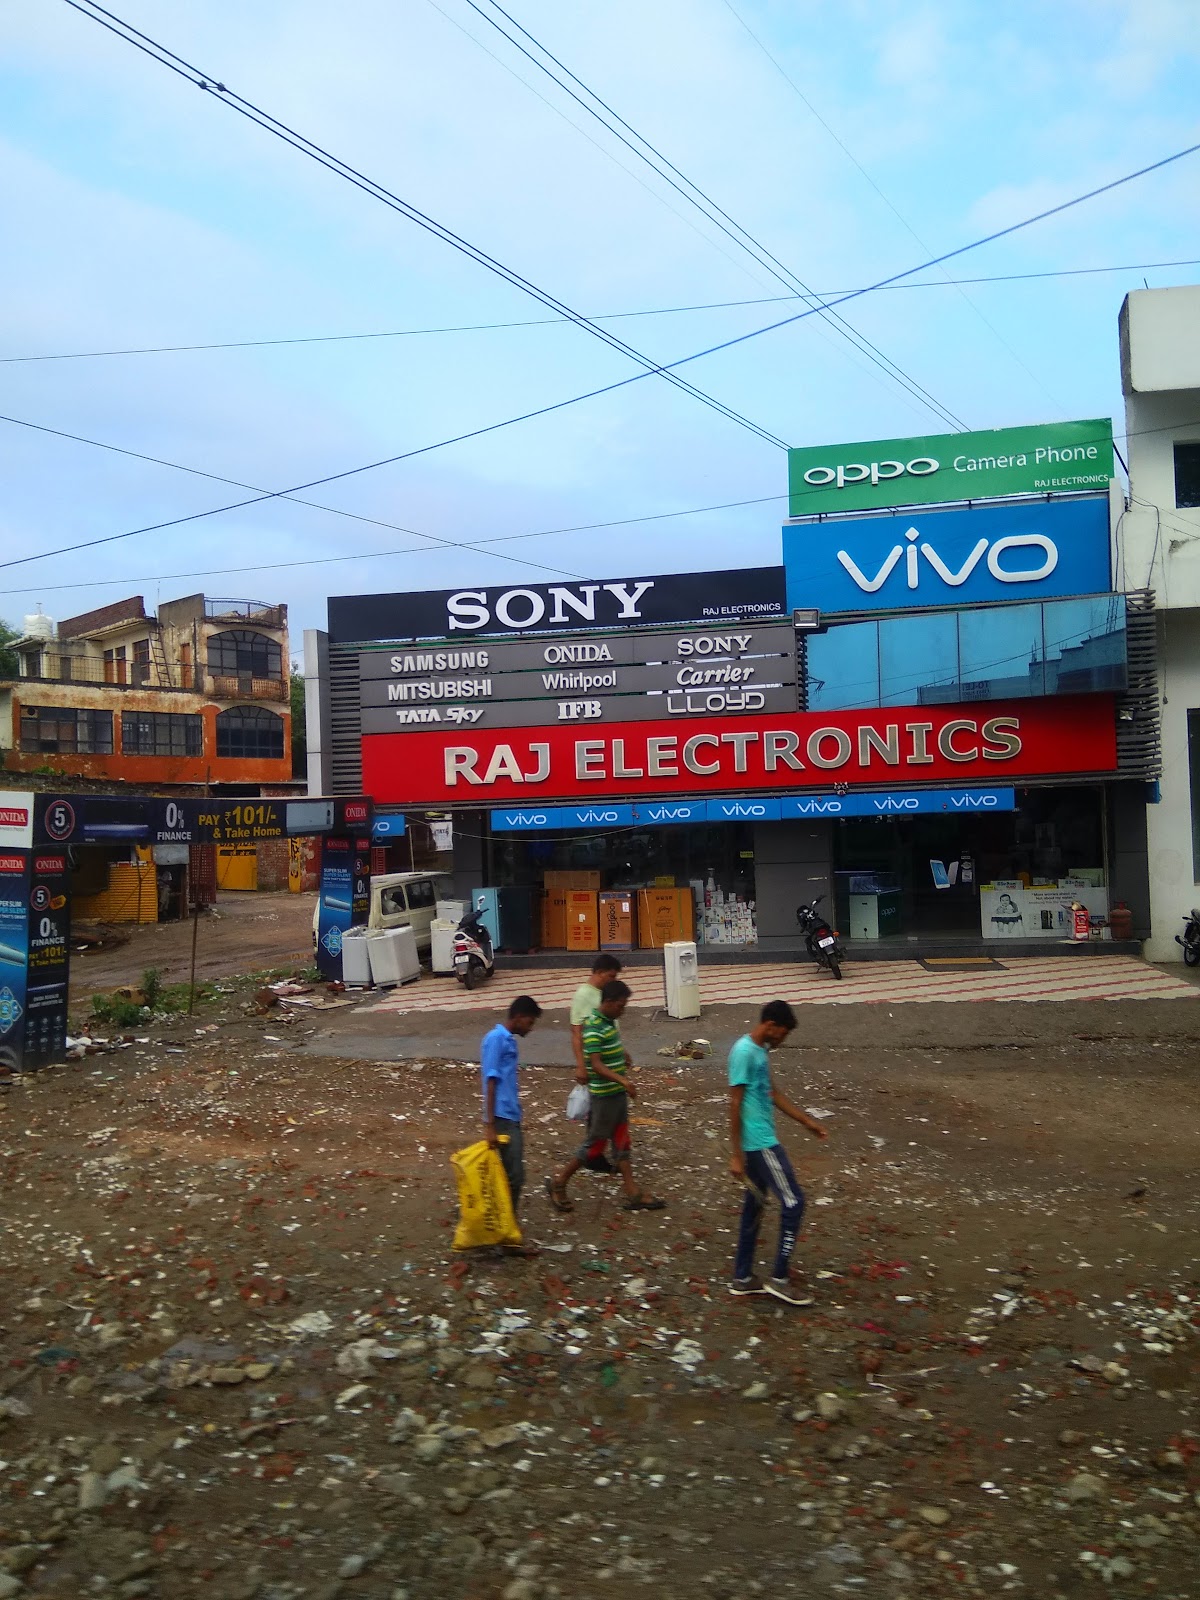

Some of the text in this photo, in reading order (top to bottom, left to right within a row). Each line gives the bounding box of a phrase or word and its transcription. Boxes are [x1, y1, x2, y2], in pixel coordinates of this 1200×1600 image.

[953, 445, 1098, 473] Camera Phone
[1034, 474, 1109, 488] RAJ ELECTRONICS
[837, 526, 1059, 593] vivo
[447, 581, 655, 631] SONY
[702, 602, 781, 616] RAJ ELECTRONICS
[544, 644, 614, 664] ONIDA
[677, 635, 752, 656] SONY
[390, 651, 489, 674] SAMSUNG
[541, 670, 617, 694] Whirlpool
[676, 665, 755, 687] Carrier
[388, 679, 492, 702] MITSUBISHI
[557, 700, 602, 721] IFB
[666, 692, 765, 714] LLOYD
[396, 707, 484, 724] TATA Sky
[444, 717, 1022, 786] RAJ ELECTRONICS
[797, 799, 842, 813] vivo
[873, 796, 919, 810] vivo
[951, 793, 998, 807] vivo
[54, 807, 66, 827] 5
[166, 802, 185, 828] 0%
[346, 807, 366, 818] ONIDA
[576, 809, 618, 823] vivo
[648, 806, 692, 820] vivo
[722, 803, 766, 816] vivo
[198, 814, 220, 826] PAY
[505, 813, 547, 826] vivo
[157, 831, 192, 840] FINANCE
[213, 827, 282, 839] & Take Home
[36, 860, 64, 870] ONIDA
[36, 890, 45, 903] 5
[39, 917, 58, 937] 0%
[608, 902, 619, 941] Whirlpool
[31, 937, 65, 947] FINANCE
